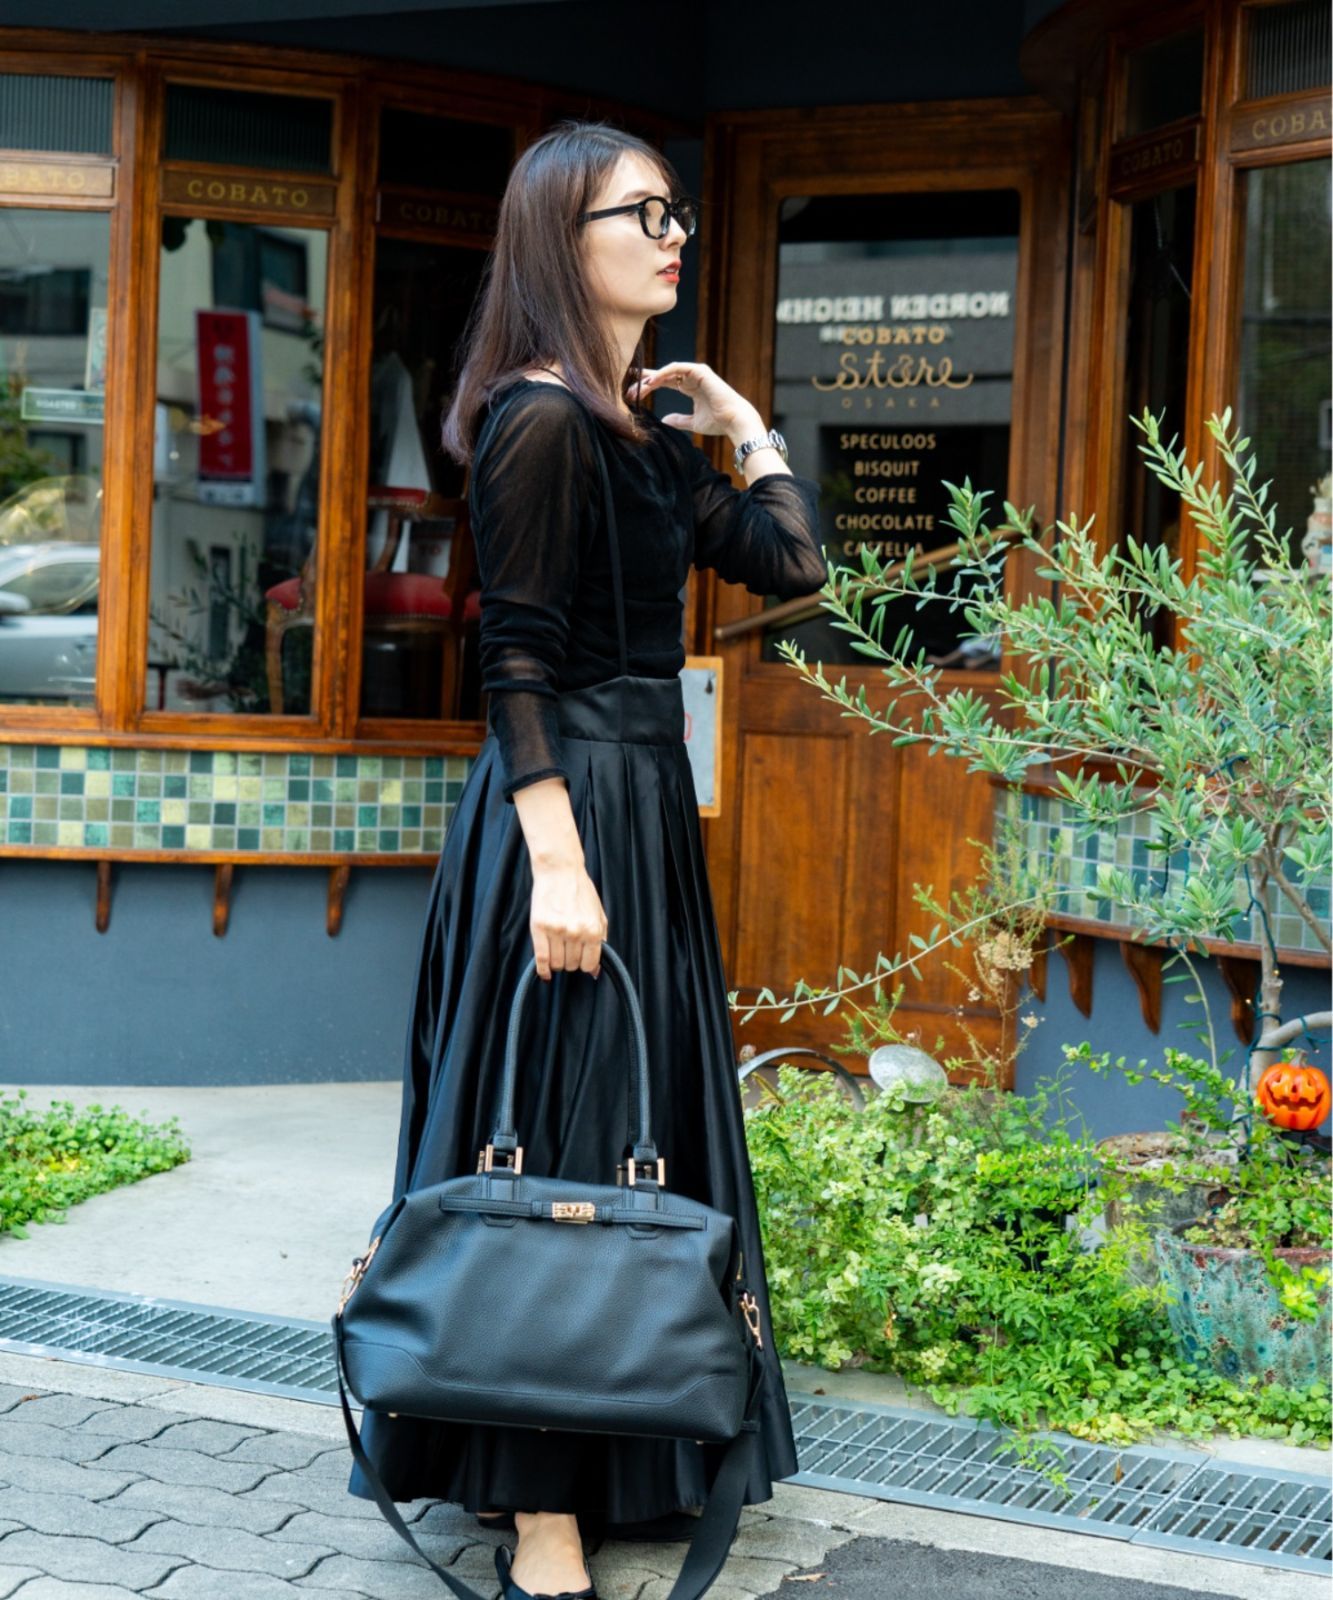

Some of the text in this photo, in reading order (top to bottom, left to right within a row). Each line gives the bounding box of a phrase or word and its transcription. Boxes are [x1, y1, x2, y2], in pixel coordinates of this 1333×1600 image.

[187, 178, 309, 209] COBATO
[841, 326, 946, 345] COBATO
[812, 350, 974, 391] Store
[840, 433, 936, 450] SPECULOOS
[854, 460, 920, 477] BISQUIT
[855, 487, 917, 504] COFFEE
[835, 513, 935, 531] CHOCOLATE
